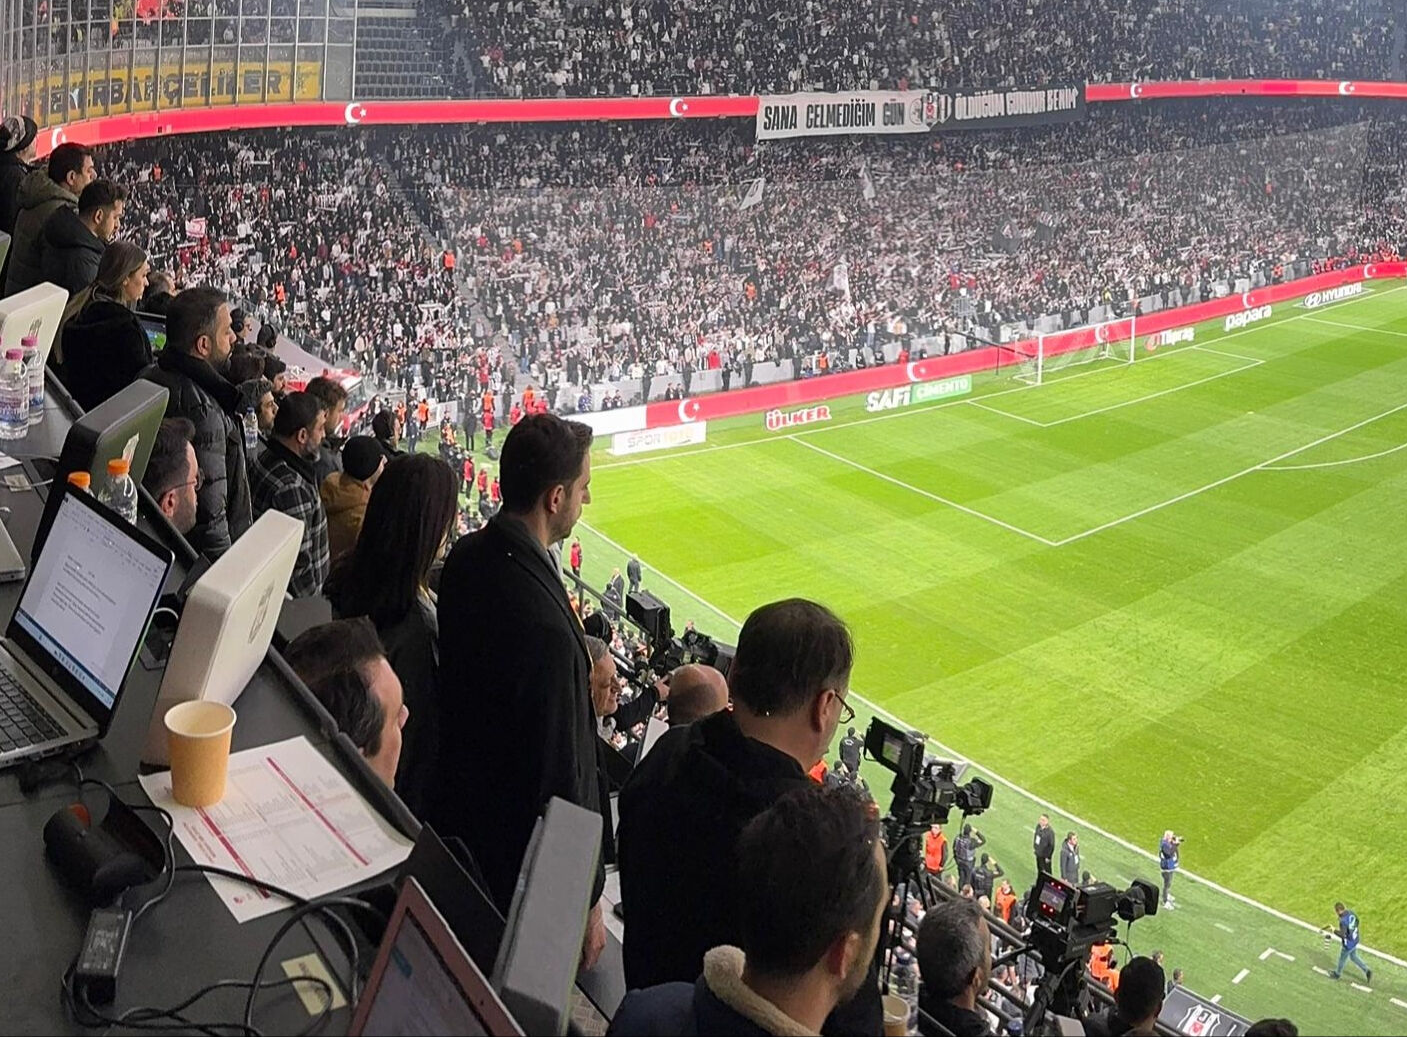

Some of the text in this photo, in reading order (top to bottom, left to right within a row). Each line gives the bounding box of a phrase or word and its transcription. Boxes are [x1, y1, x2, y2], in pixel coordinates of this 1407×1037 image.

[763, 105, 797, 131] SANA
[806, 98, 875, 128] GELMEDİĞİM
[882, 98, 905, 126] GÜN
[1322, 282, 1362, 303] HYUNDAI
[1224, 305, 1272, 332] papara
[766, 406, 830, 430] ÜLKER
